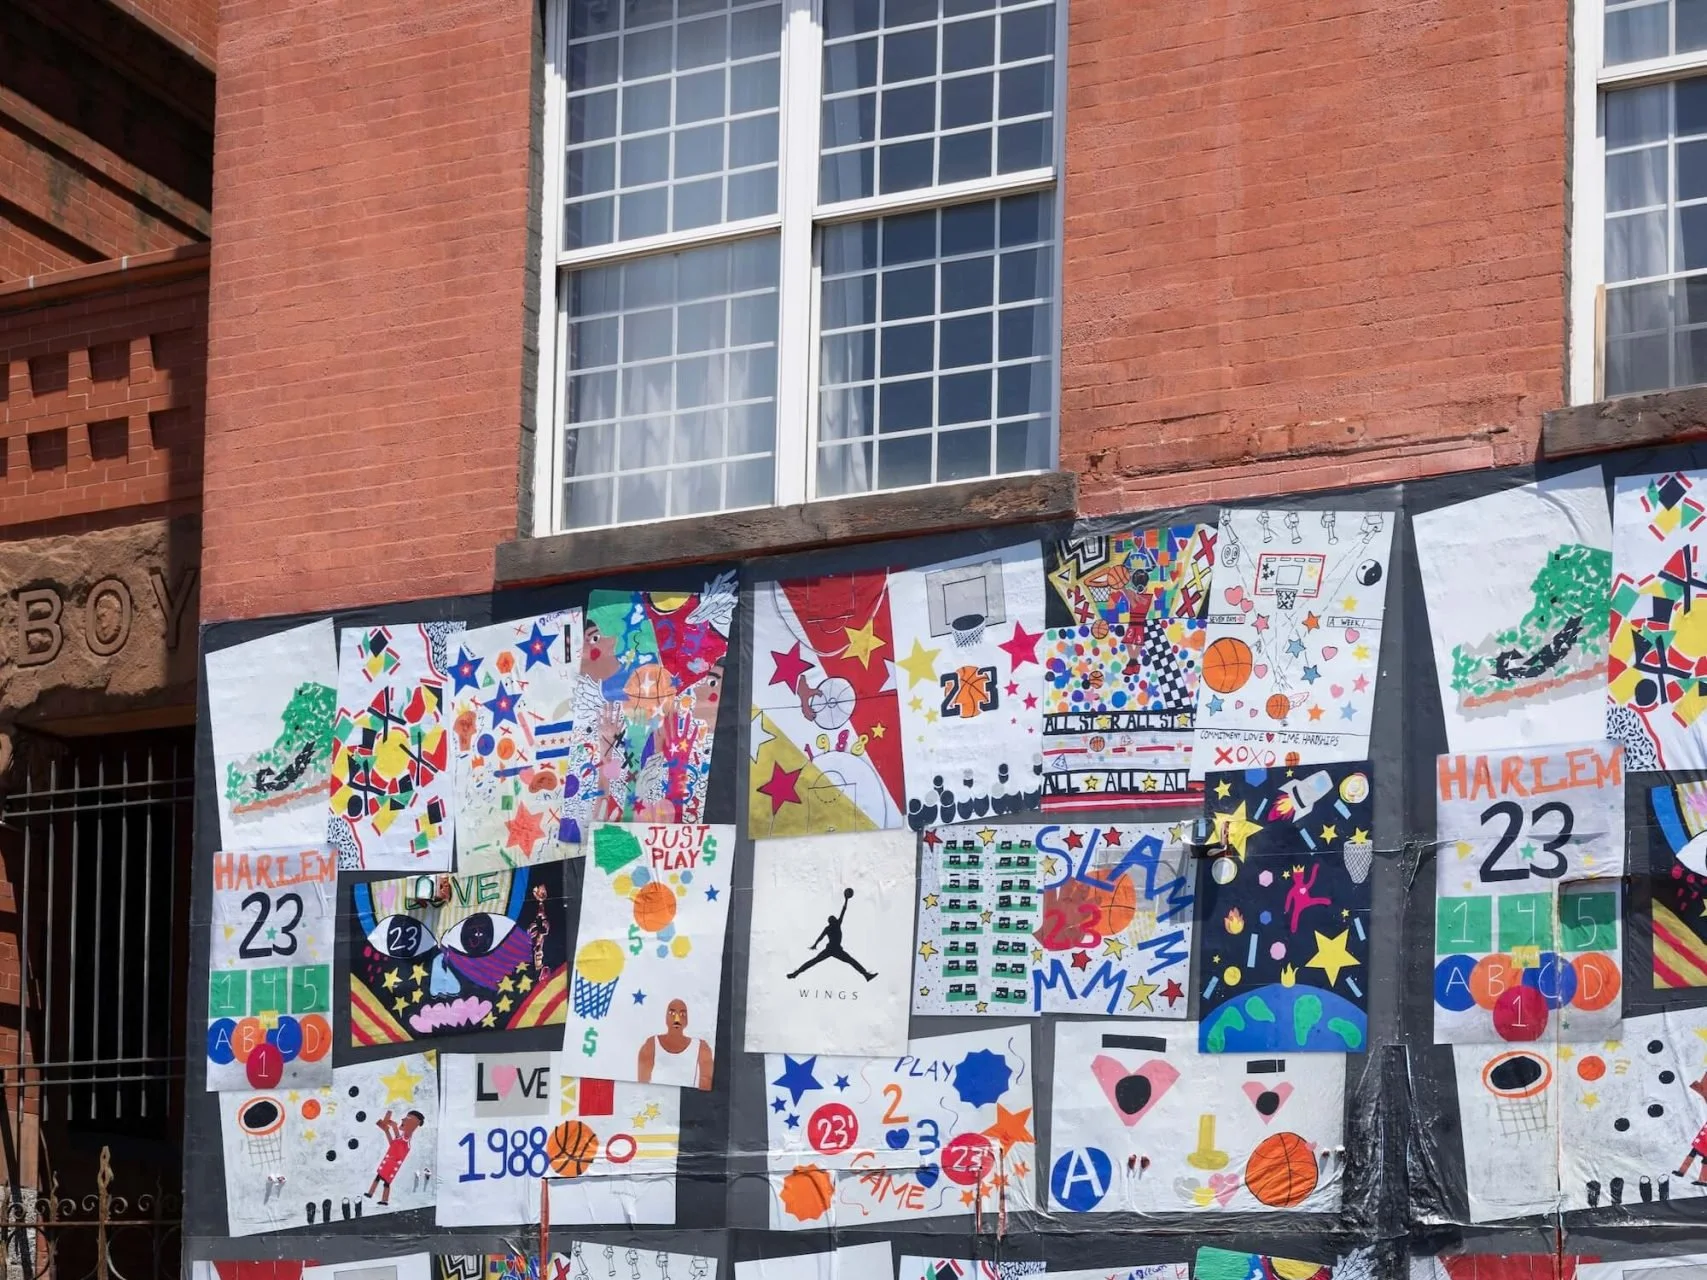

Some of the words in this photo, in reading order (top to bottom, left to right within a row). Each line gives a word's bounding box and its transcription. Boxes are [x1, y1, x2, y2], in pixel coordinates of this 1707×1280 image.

[939, 665, 999, 718] 23
[804, 729, 868, 763] 1988
[1243, 731, 1264, 742] LOVE
[1214, 746, 1277, 767] XOXO
[1438, 745, 1626, 801] HARLEM
[1105, 772, 1140, 793] ALL
[645, 825, 710, 848] JUST
[1480, 801, 1574, 882] 23
[213, 850, 338, 891] HARLEM
[651, 848, 700, 870] PLAY
[238, 892, 304, 959] 23
[389, 926, 418, 951] 23
[1043, 903, 1102, 950] 23
[799, 988, 859, 1000] WINGS
[893, 1055, 955, 1083] PLAY
[458, 1126, 552, 1183] 1988
[850, 1151, 926, 1211] GAME
[1061, 1148, 1105, 1200] A
